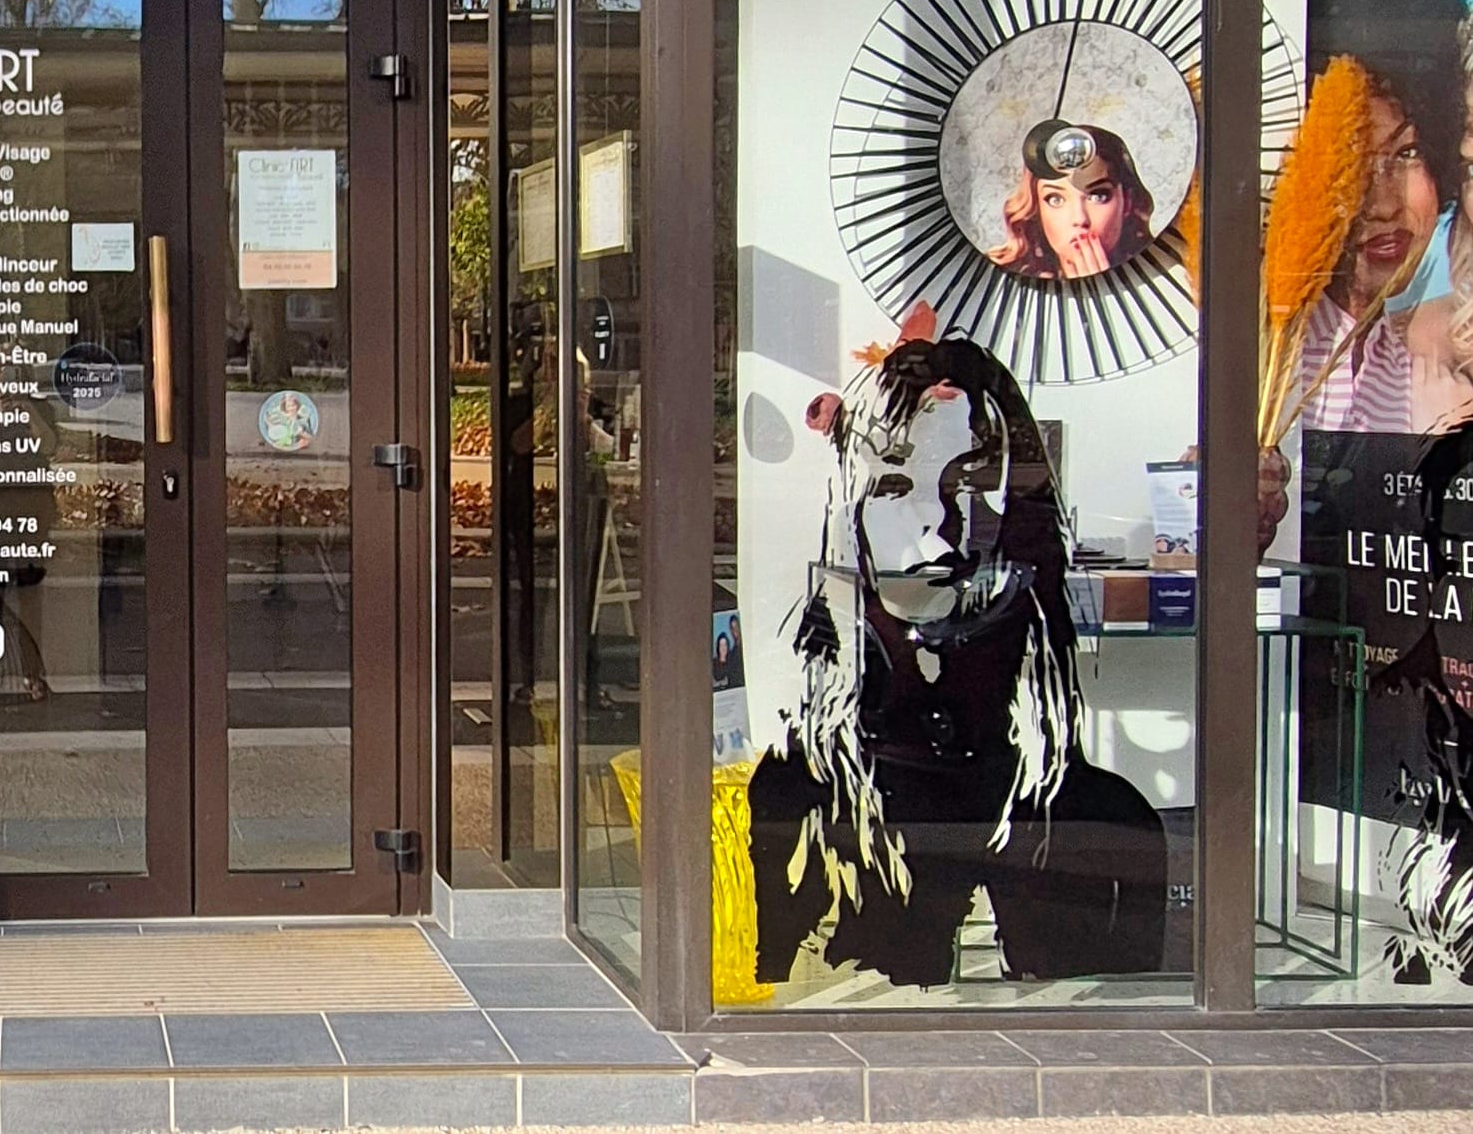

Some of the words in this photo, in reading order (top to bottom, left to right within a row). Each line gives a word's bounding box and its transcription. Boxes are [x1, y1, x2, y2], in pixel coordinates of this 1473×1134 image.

[24, 278, 44, 293] de
[48, 278, 89, 293] choc
[20, 318, 79, 335] Manuel
[15, 438, 42, 454] UV
[17, 517, 38, 533] 78
[1347, 529, 1376, 568] LE
[1385, 577, 1419, 617] DE
